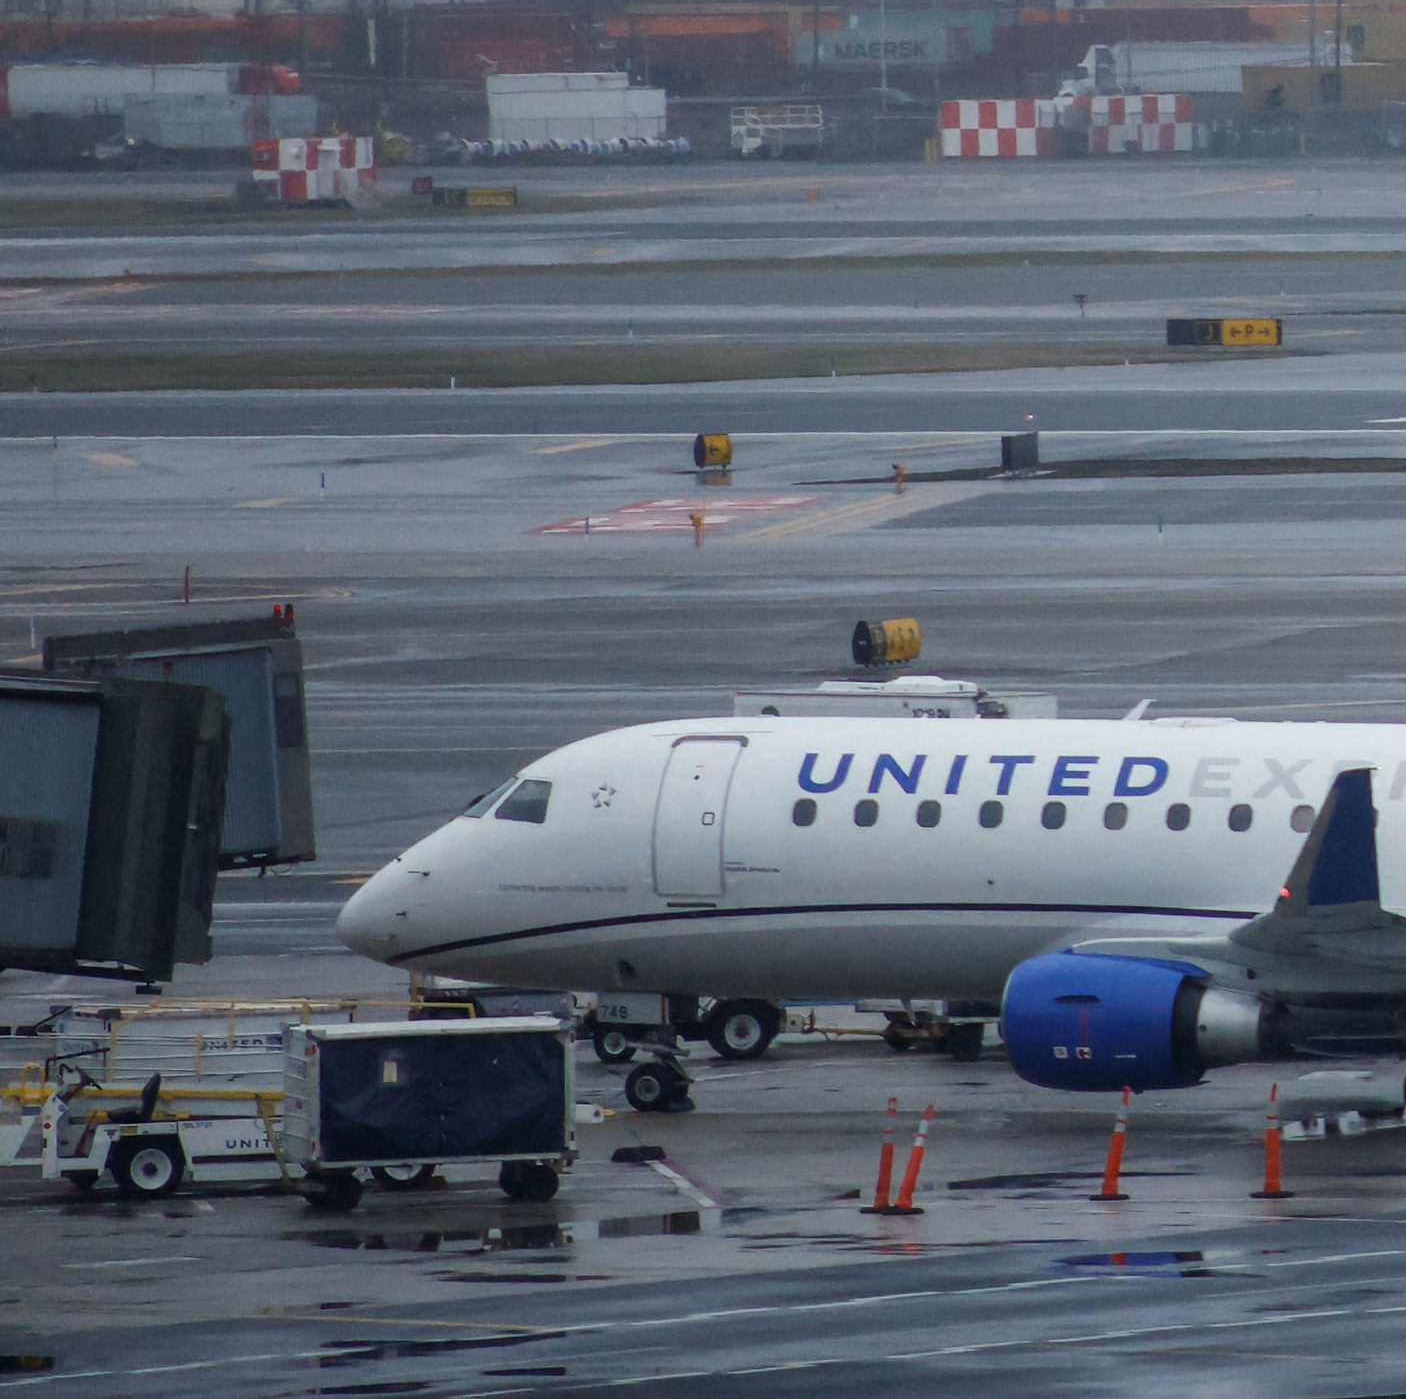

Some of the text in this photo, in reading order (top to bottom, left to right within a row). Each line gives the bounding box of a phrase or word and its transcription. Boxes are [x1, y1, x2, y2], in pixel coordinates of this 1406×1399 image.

[832, 39, 930, 59] MAERSK
[797, 752, 1170, 797] UNITED
[226, 1139, 284, 1150] UNITE
